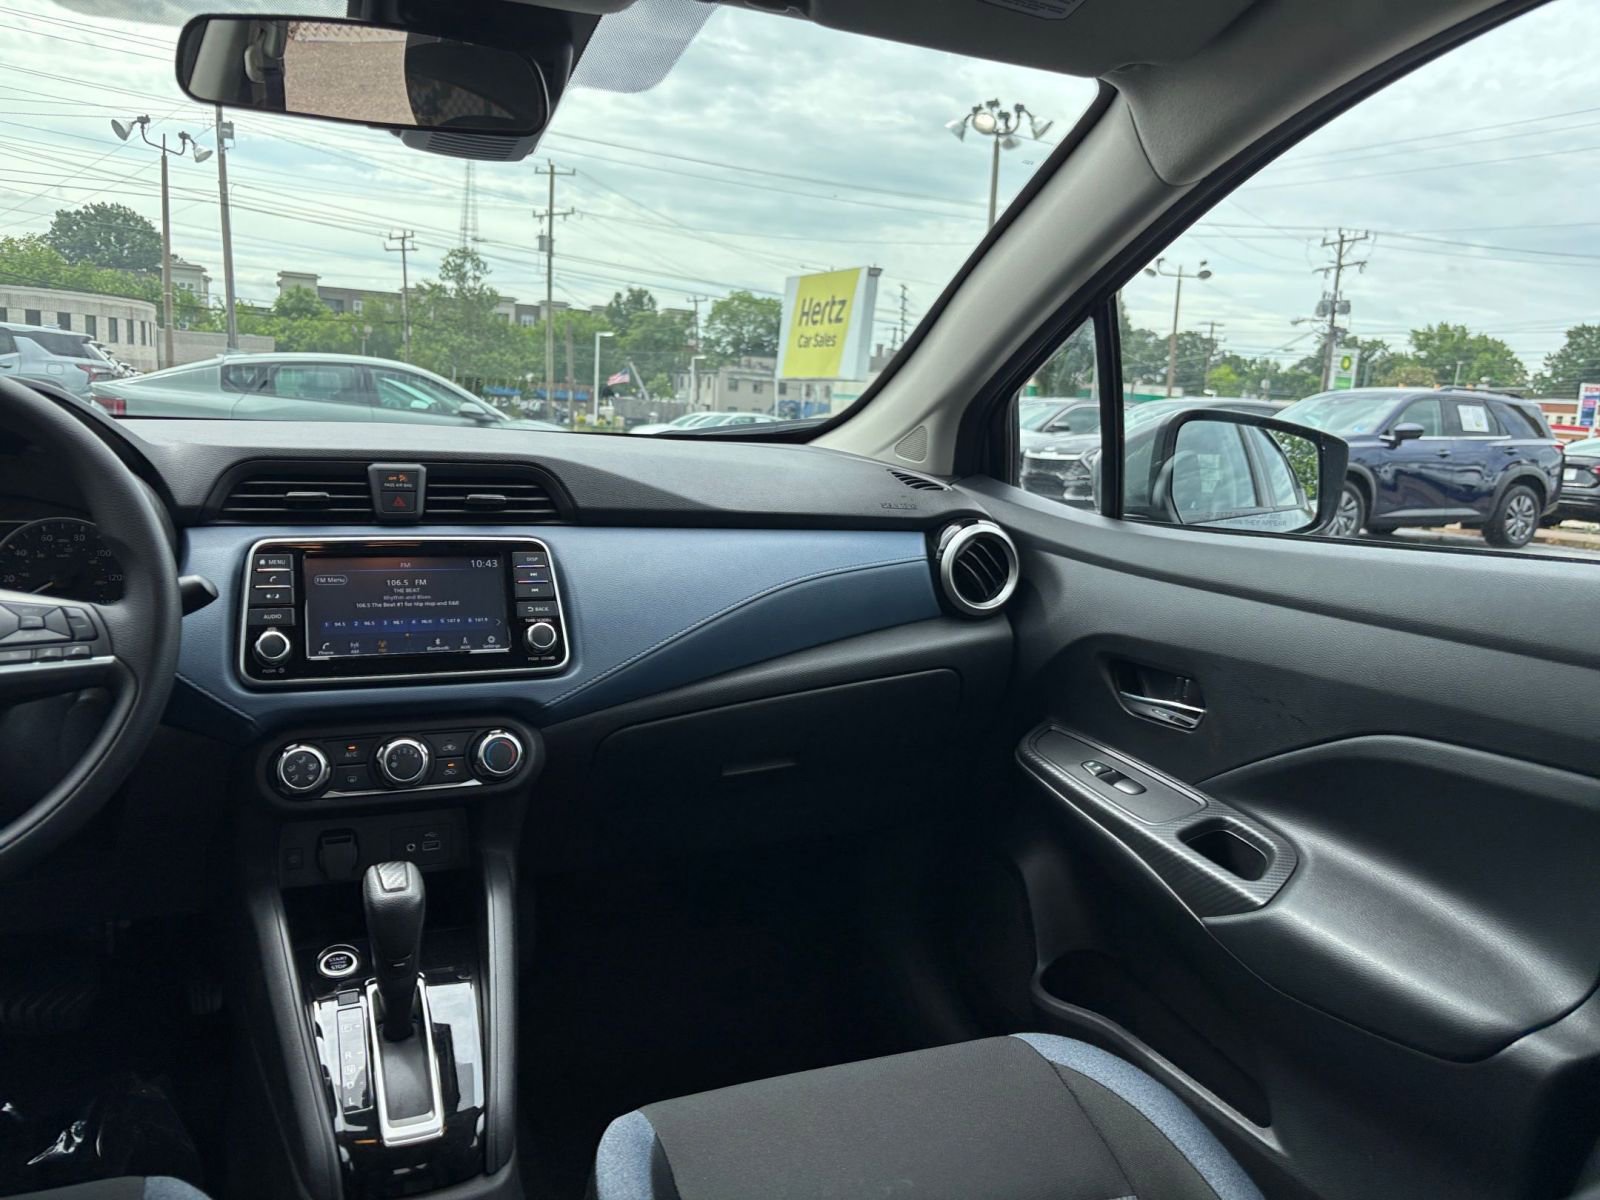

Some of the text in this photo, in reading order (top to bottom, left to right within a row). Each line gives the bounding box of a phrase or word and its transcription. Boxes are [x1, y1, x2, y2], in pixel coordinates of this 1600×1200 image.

[798, 294, 847, 327] Hertz
[798, 333, 837, 348] Car Sales
[97, 549, 112, 557] 100
[471, 560, 498, 568] 10:43
[4, 574, 16, 582] 20
